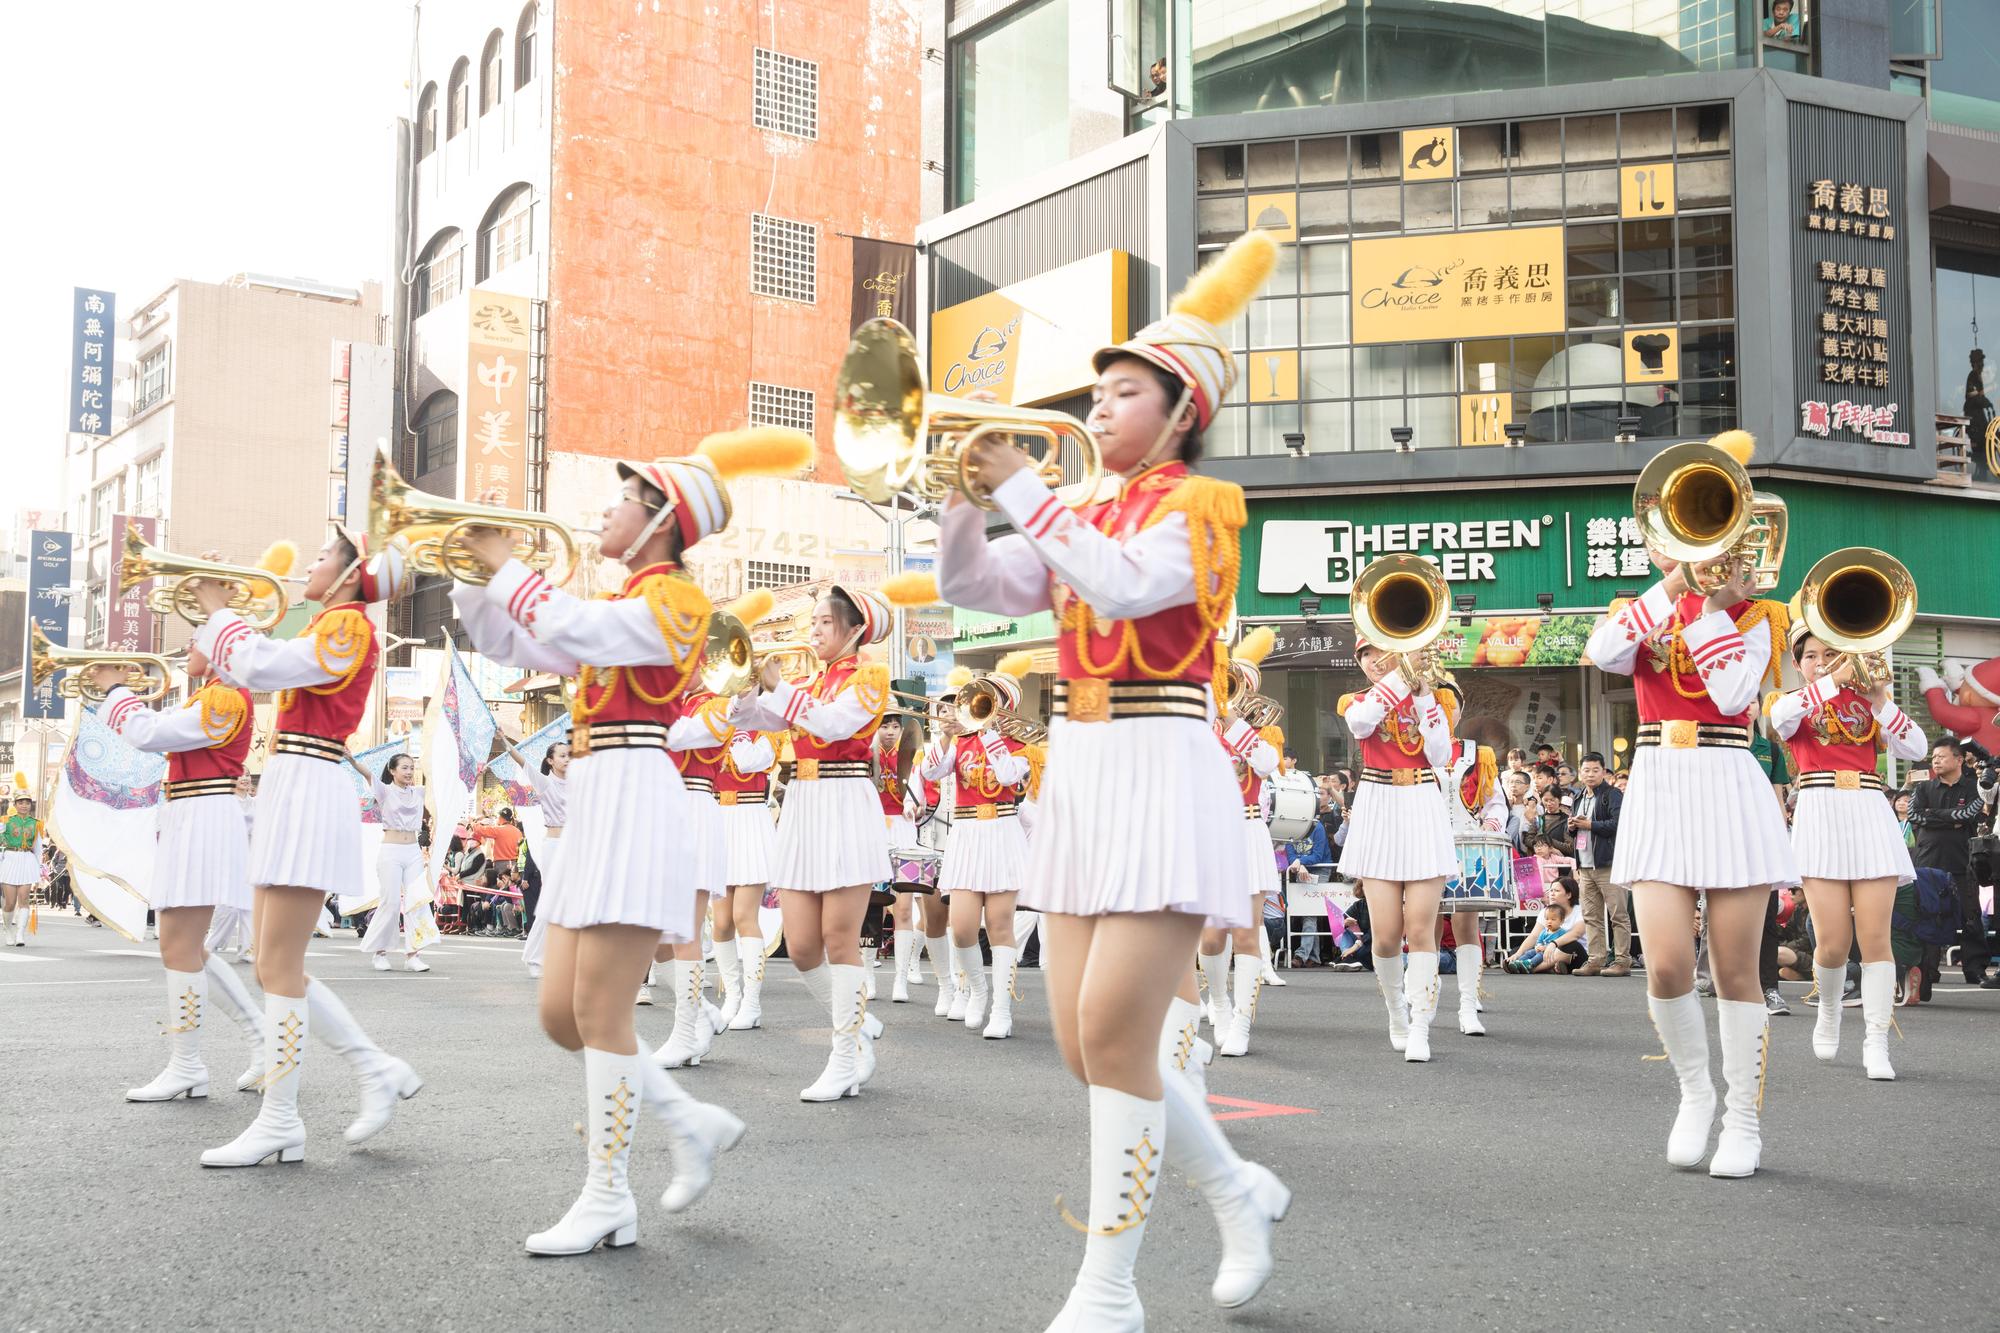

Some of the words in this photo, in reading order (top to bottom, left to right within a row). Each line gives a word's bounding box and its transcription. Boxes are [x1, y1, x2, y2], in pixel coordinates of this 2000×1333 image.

[1811, 179, 1890, 218] 喬義思
[1808, 214, 1895, 240] 窯烤手作廚房
[863, 278, 897, 293] Choice
[1464, 263, 1551, 293] 喬義思
[1821, 260, 1887, 288] 窯烤披薩
[1361, 288, 1441, 309] Choice
[1461, 291, 1552, 307] 窯烤手作廚房
[1830, 285, 1879, 312] 烤全雞
[1822, 312, 1888, 338] 義大利麵
[1823, 337, 1888, 362] 義式小點
[80, 294, 105, 433] 南無阿彌陀佛
[944, 360, 1006, 392] Choice
[1824, 362, 1888, 388] 炙烤牛排
[475, 354, 520, 459] 中美
[1324, 519, 1541, 553] THEFREEN
[1586, 516, 1643, 546] 樂檸
[1327, 552, 1496, 582] BER
[1586, 547, 1651, 577] 漢堡
[1436, 638, 1468, 649] PURE
[1487, 636, 1526, 648] VALUE
[1544, 635, 1577, 647] CARE
